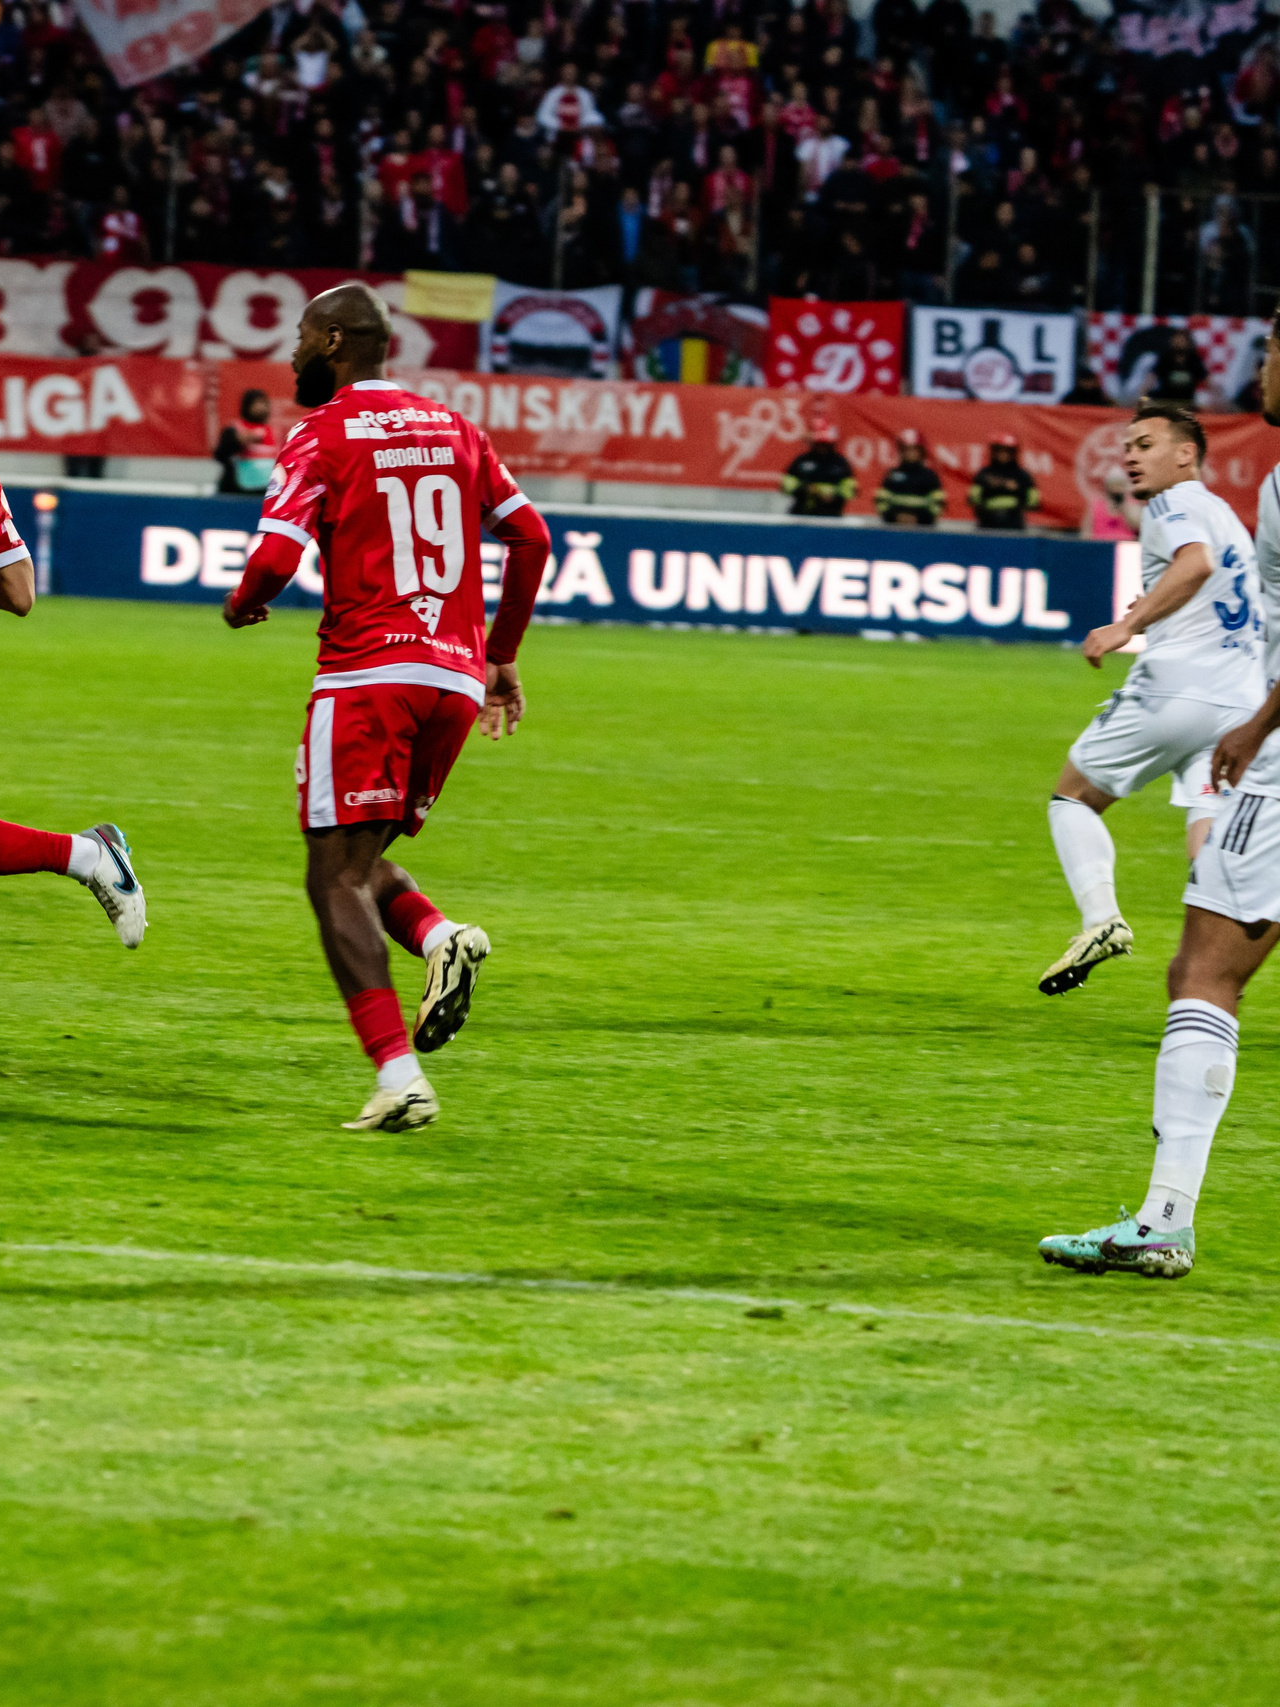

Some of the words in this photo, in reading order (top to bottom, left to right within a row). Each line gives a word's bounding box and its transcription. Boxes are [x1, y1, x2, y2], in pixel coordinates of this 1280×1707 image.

[372, 446, 455, 470] ABDALLAH
[376, 474, 465, 597] 19
[628, 548, 1072, 631] UNIVERSUL
[421, 635, 474, 660] GAMING
